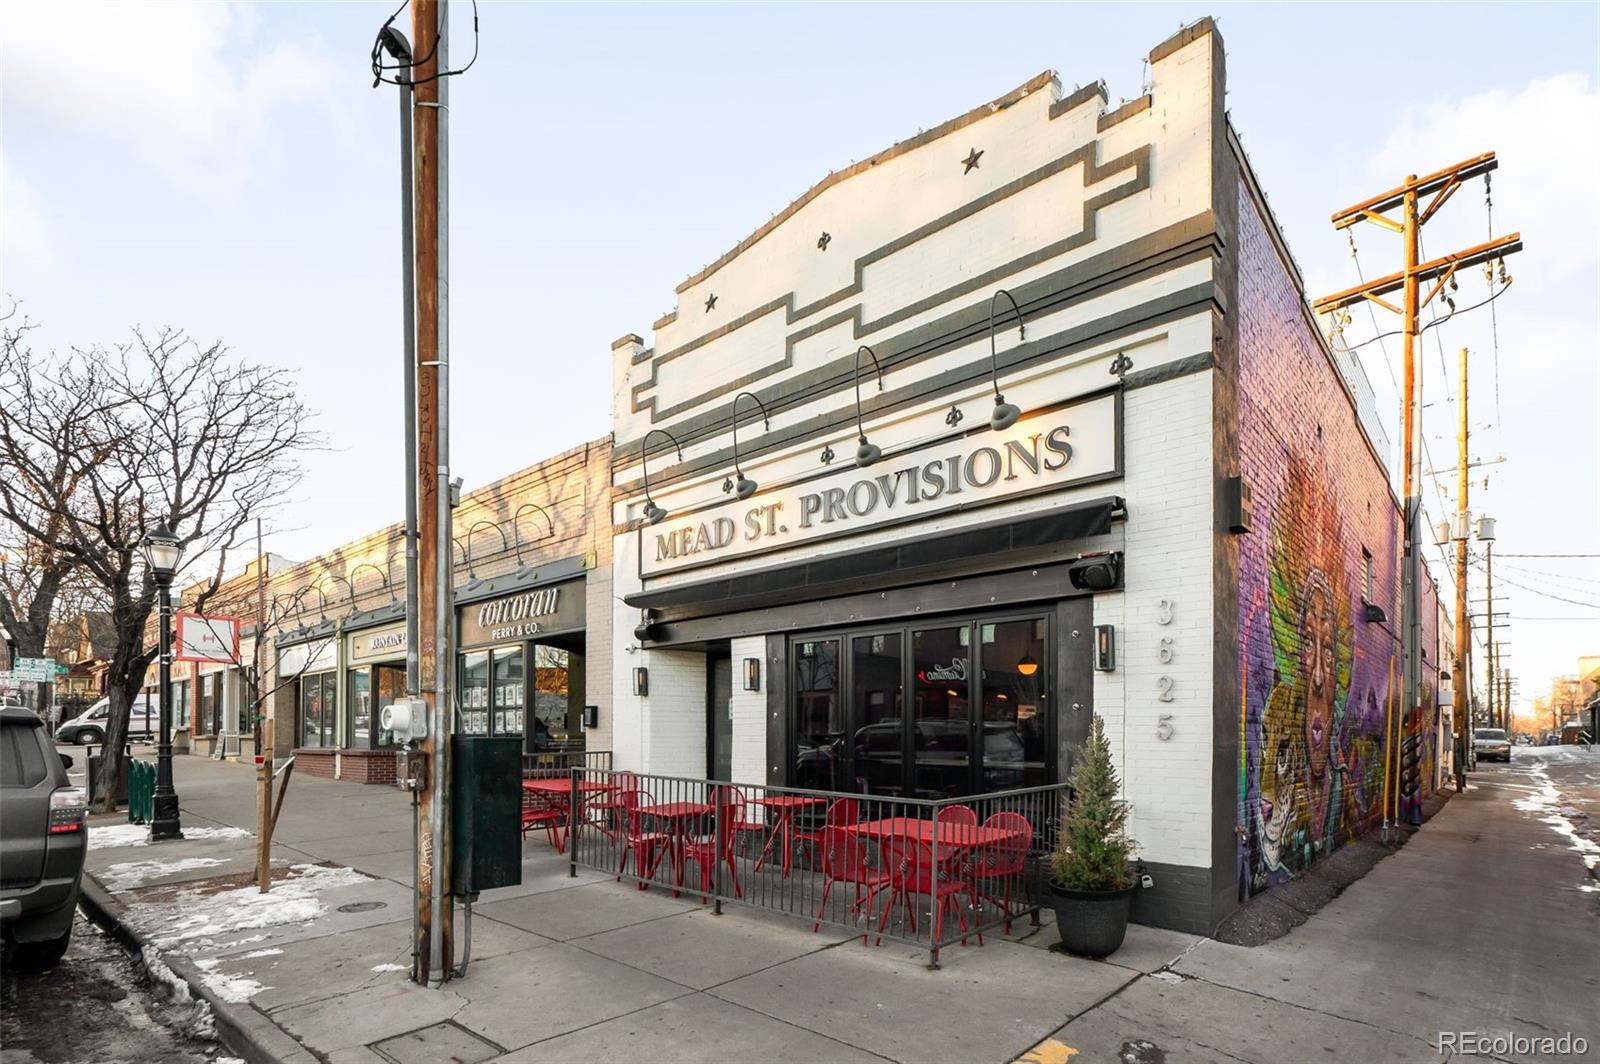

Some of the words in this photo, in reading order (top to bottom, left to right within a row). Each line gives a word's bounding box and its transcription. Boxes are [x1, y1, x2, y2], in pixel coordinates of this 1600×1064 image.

[656, 516, 735, 562] MEAD
[744, 501, 788, 541] ST.
[798, 425, 1074, 529] PROVISIONS
[478, 588, 559, 628] corcoran
[491, 626, 516, 640] PERRY
[517, 624, 523, 636] &
[525, 622, 541, 635] CO.
